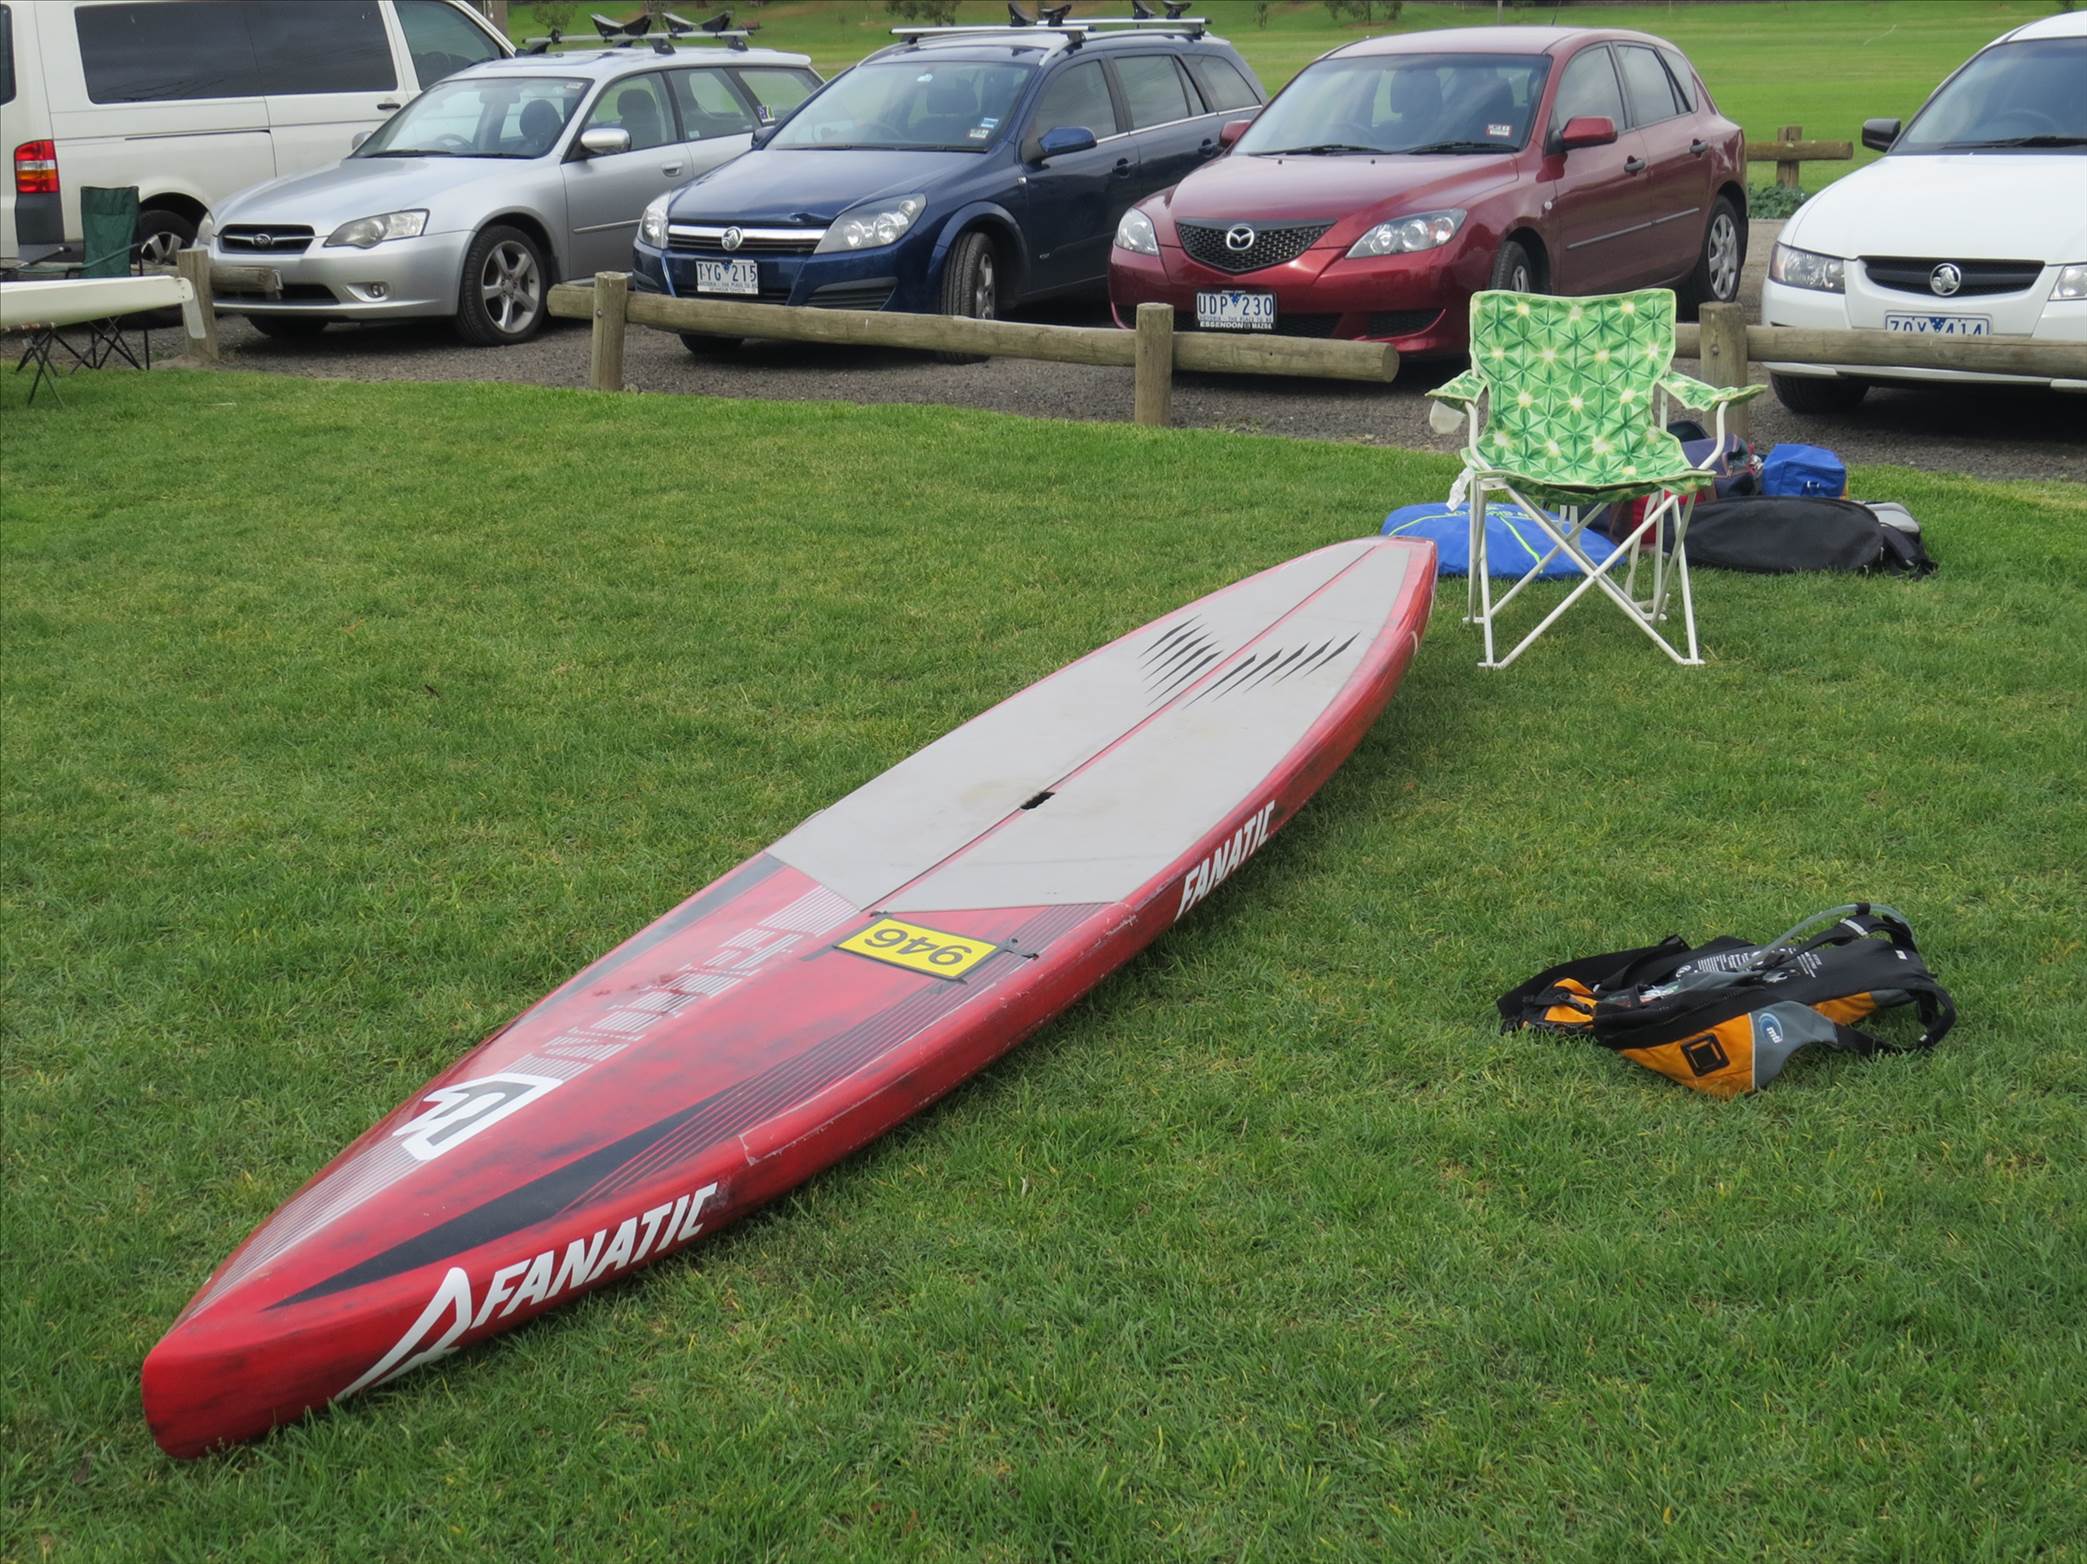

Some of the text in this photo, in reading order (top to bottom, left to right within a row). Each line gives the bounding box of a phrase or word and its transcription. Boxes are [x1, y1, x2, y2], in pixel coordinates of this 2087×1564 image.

[698, 263, 757, 282] TYG 215
[1198, 295, 1273, 316] UDP 230
[1173, 799, 1275, 923] FANATIC
[864, 928, 972, 966] 946
[470, 1182, 718, 1330] FANATIC
